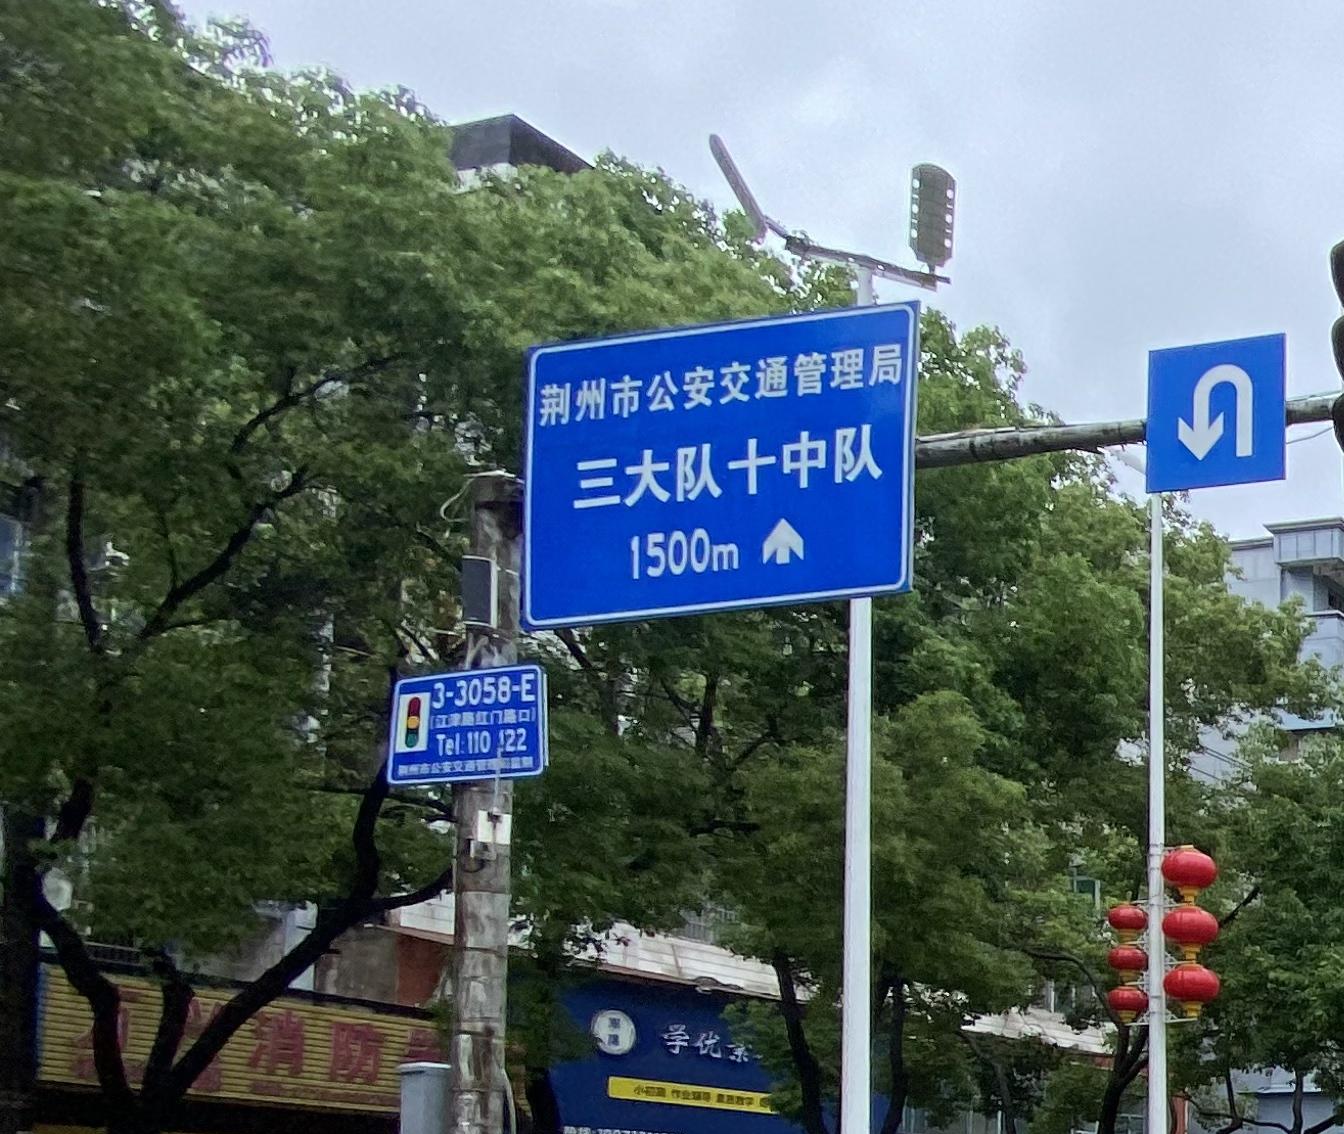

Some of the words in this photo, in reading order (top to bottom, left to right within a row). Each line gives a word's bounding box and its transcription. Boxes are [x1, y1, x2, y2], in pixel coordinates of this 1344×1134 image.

[538, 343, 903, 428] 荆州市公安交通管理局
[572, 423, 884, 510] 三大队十中队
[630, 527, 740, 580] 1500m
[431, 672, 536, 709] 3-3058-E
